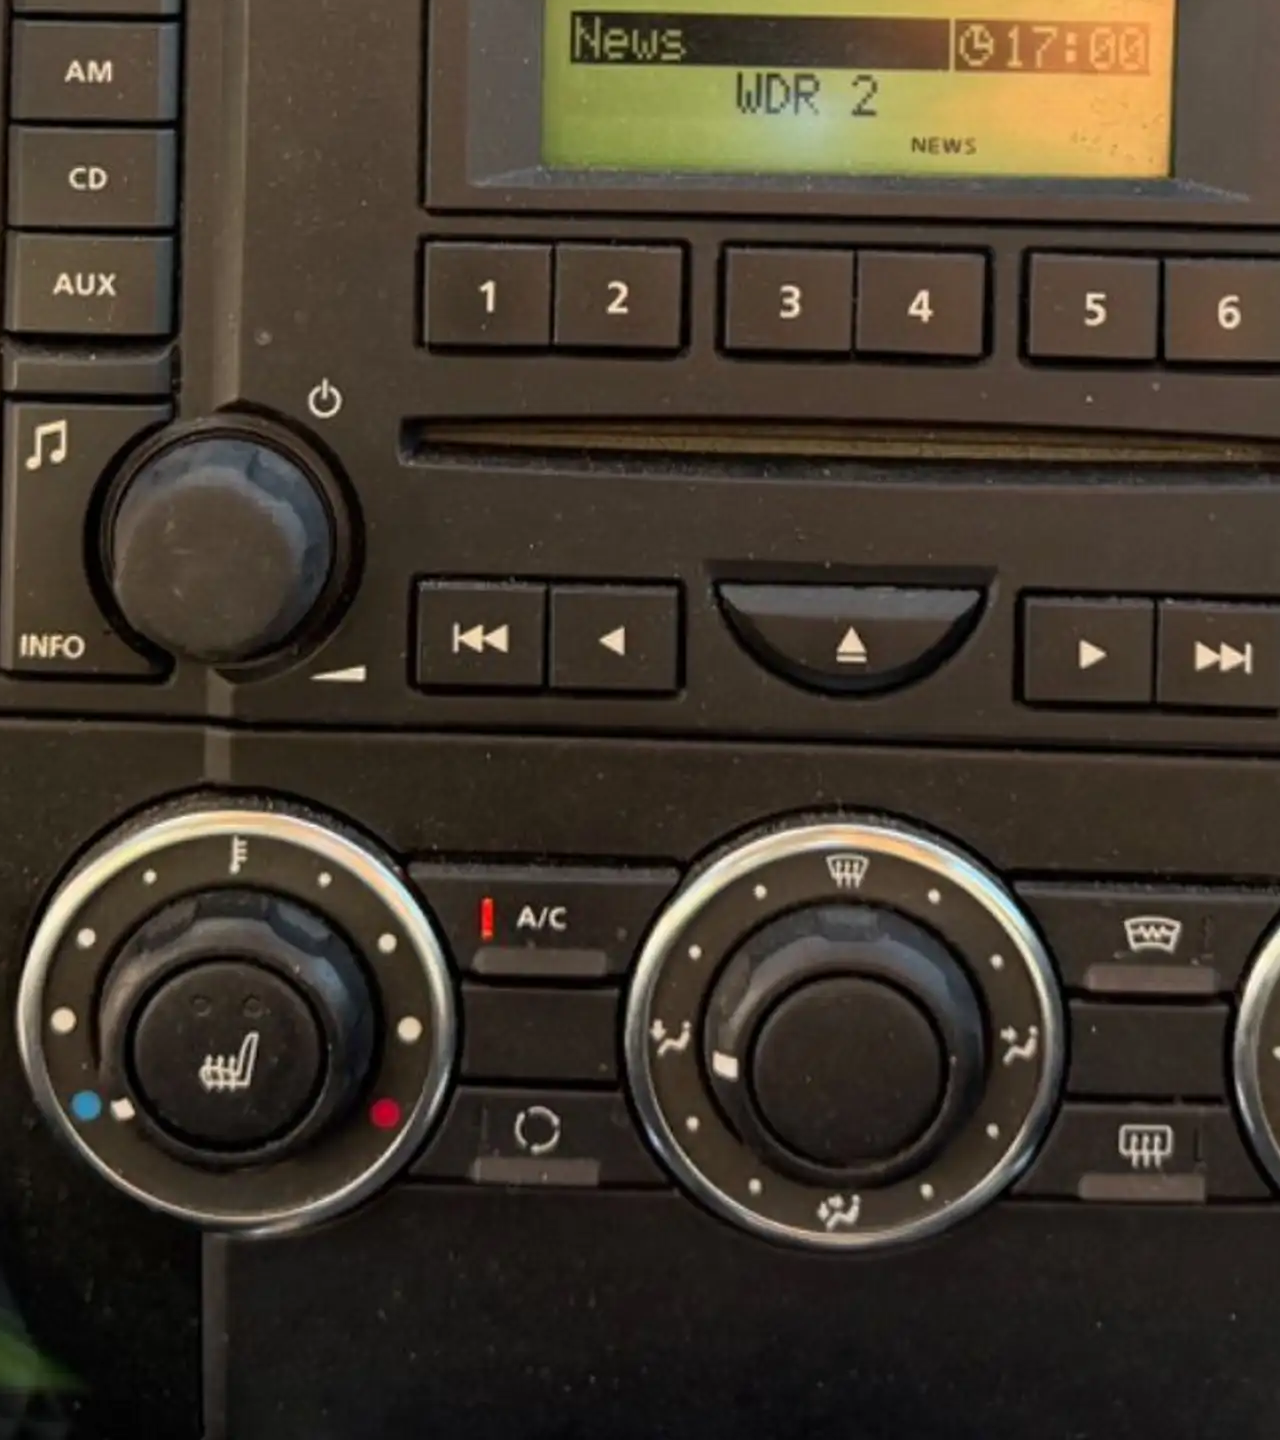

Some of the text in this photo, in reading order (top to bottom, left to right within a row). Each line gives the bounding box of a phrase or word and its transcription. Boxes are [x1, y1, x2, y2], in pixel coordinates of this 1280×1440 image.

[573, 16, 688, 62] News
[1006, 26, 1150, 71] 17:00
[64, 60, 114, 83] AM
[735, 71, 880, 117] WDR 2
[911, 136, 978, 157] NEWS
[68, 167, 108, 191] CD
[52, 273, 117, 297] AUX
[479, 280, 497, 314] 1
[606, 281, 629, 315] 2
[779, 285, 801, 319] 3
[907, 289, 934, 323] 4
[1084, 293, 1108, 327] 5
[1217, 295, 1242, 330] 6
[19, 634, 86, 659] INFO
[516, 905, 567, 930] A/C
